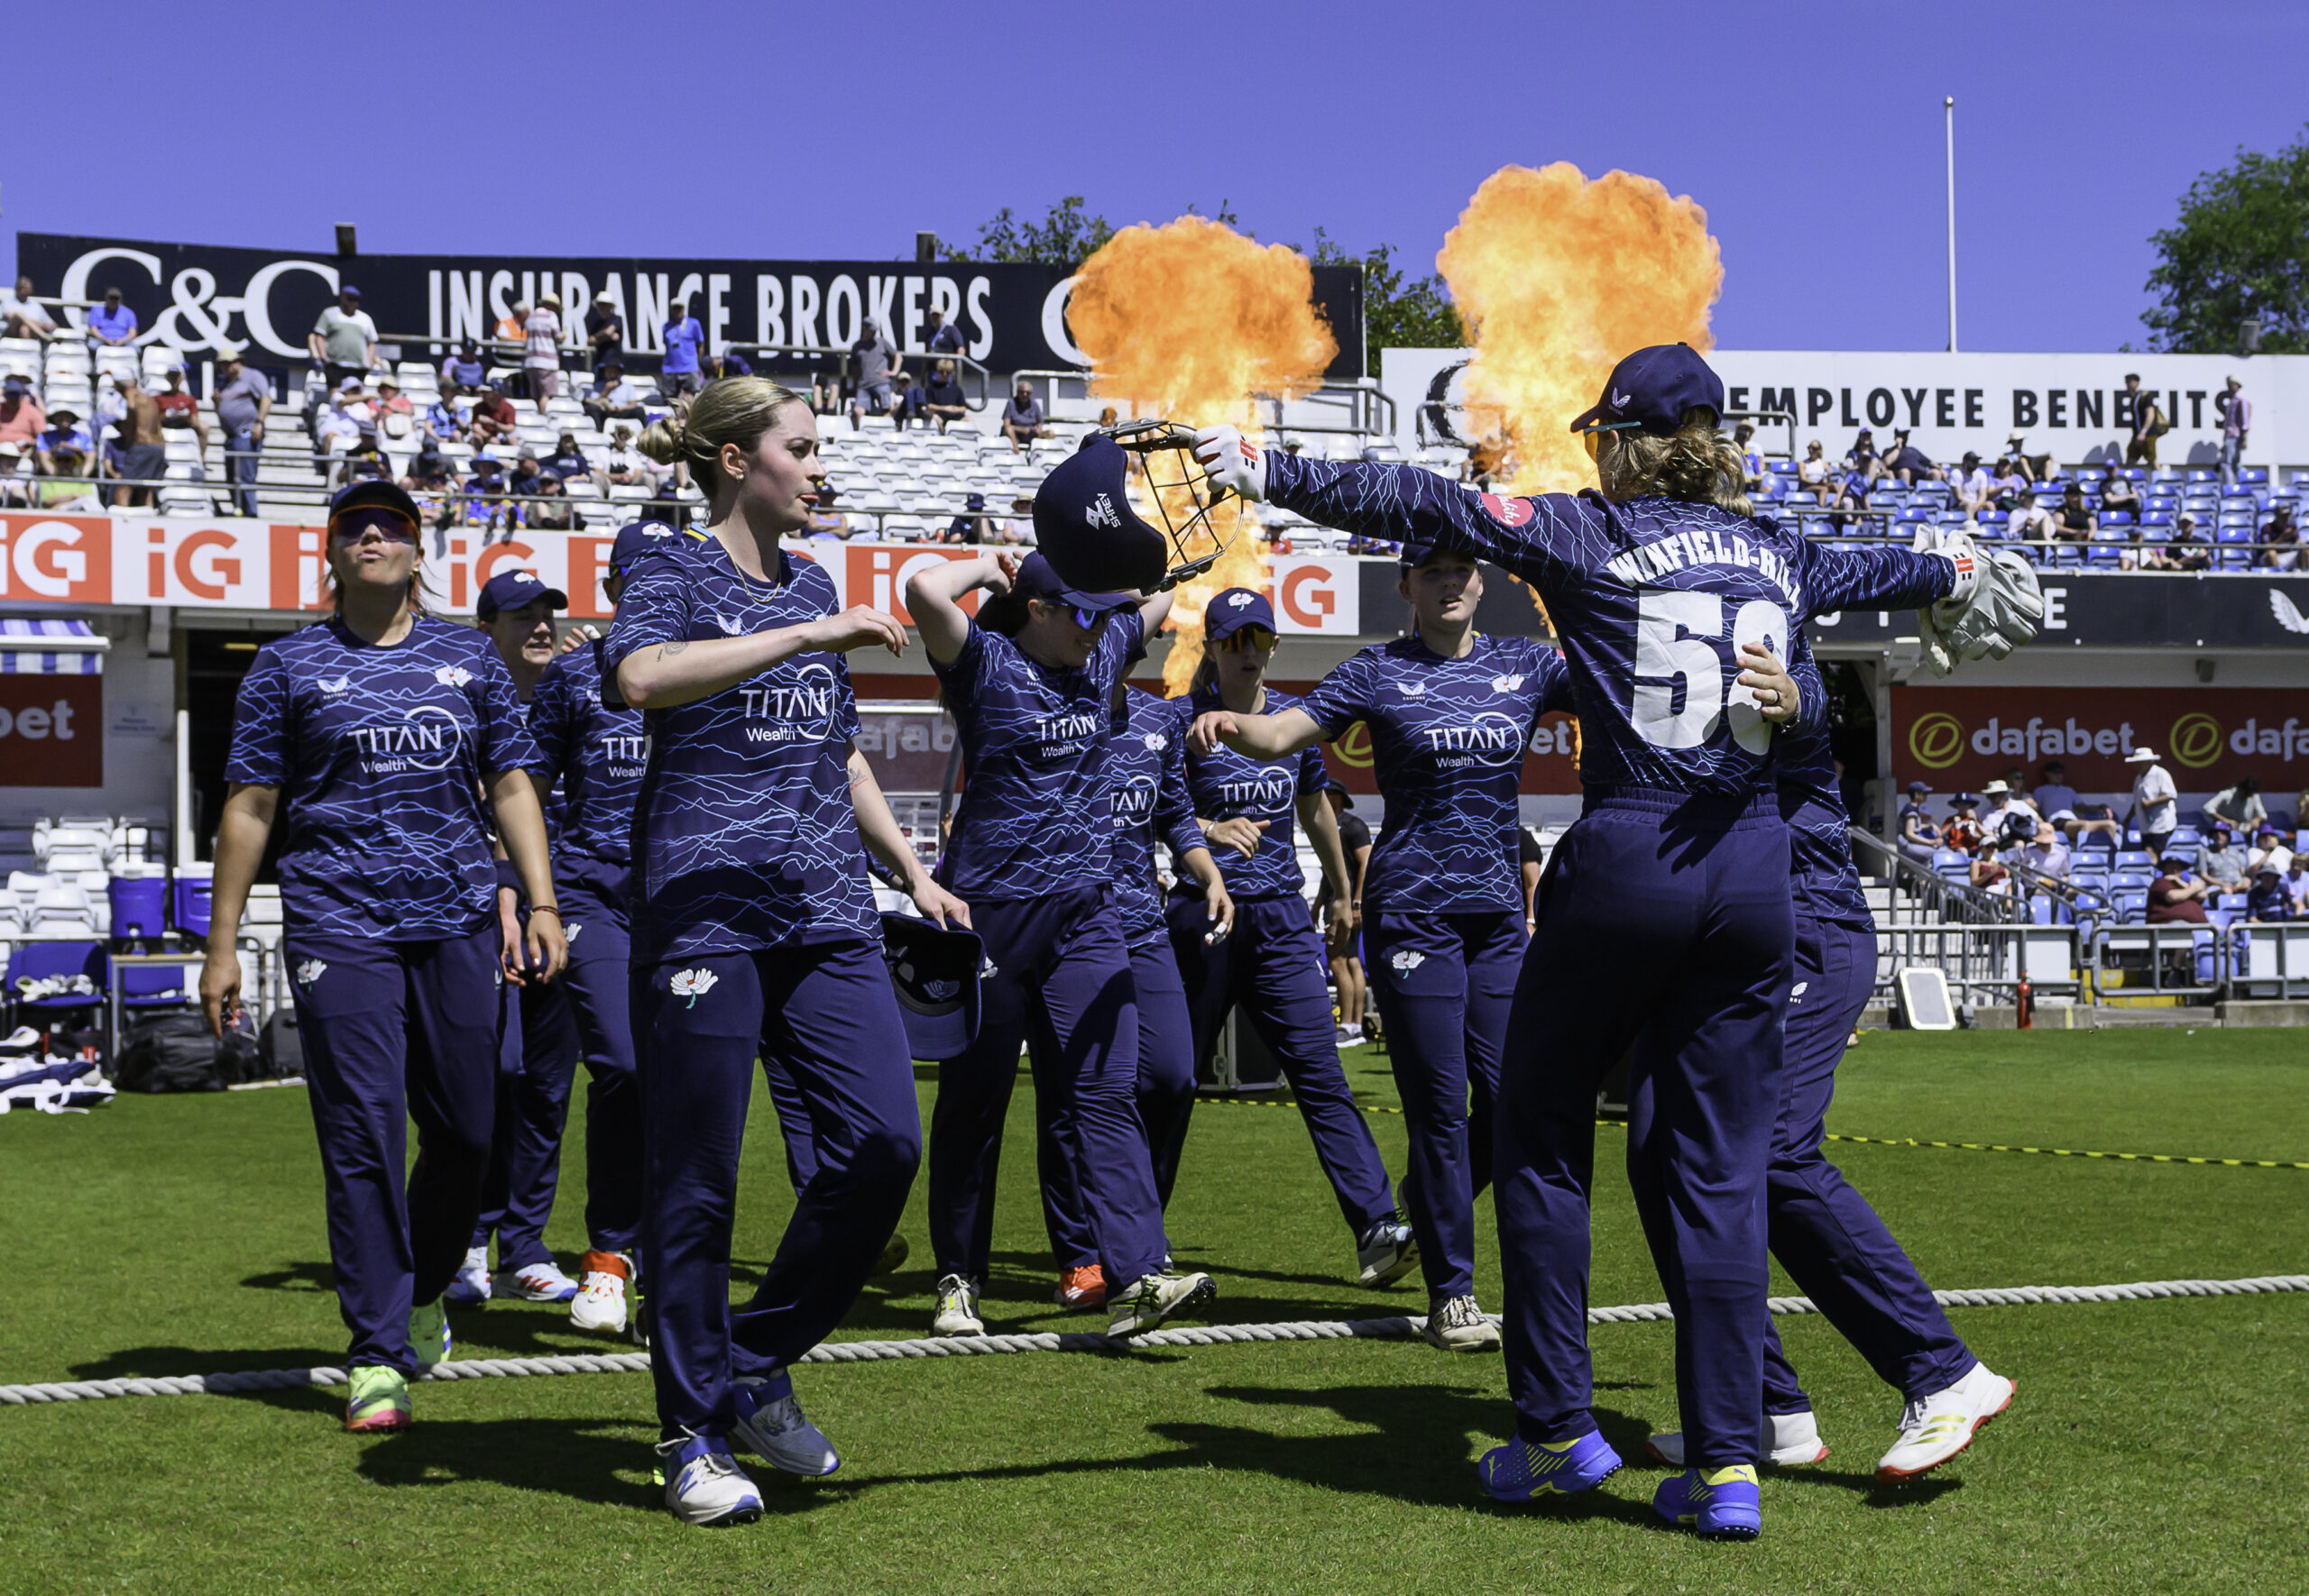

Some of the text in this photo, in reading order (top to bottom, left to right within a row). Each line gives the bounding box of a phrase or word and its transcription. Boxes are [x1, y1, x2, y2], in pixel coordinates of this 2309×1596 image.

[1729, 387, 2233, 428] EMPLOYEE BENEITS
[1097, 493, 1121, 527] SHREY
[148, 527, 241, 600] iG
[739, 687, 827, 719] TITAN
[346, 724, 441, 754] TITAN
[746, 727, 796, 742] Wealth
[1036, 714, 1097, 741] TITAN
[1423, 727, 1506, 751] TITAN
[1971, 717, 2135, 763] dafabet
[1041, 744, 1075, 757] Wealth
[1436, 756, 1475, 768] Wealth
[361, 759, 407, 774] Wealth
[1218, 780, 1282, 802] TITAN
